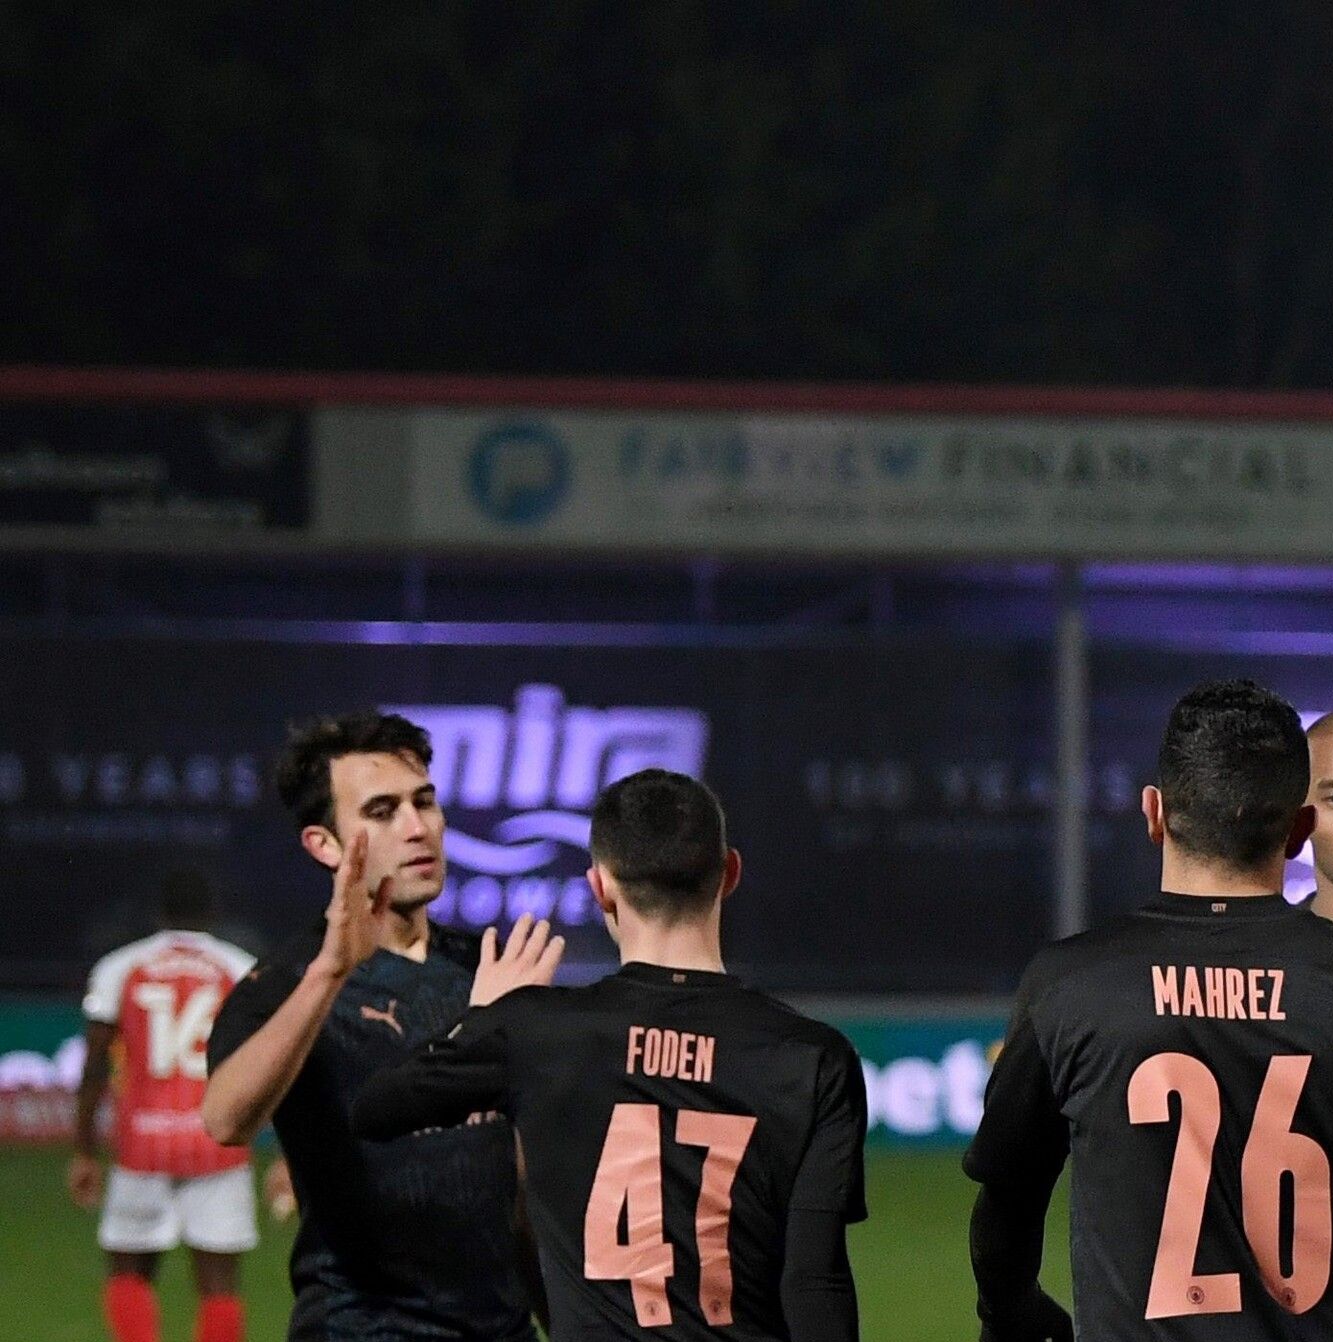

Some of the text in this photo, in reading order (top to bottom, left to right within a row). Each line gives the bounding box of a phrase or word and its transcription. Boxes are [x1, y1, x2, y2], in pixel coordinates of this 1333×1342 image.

[626, 1025, 716, 1083] FODEN
[1152, 964, 1286, 1021] MAHREZ
[584, 1103, 758, 1328] 47
[1127, 1051, 1332, 1321] 26
